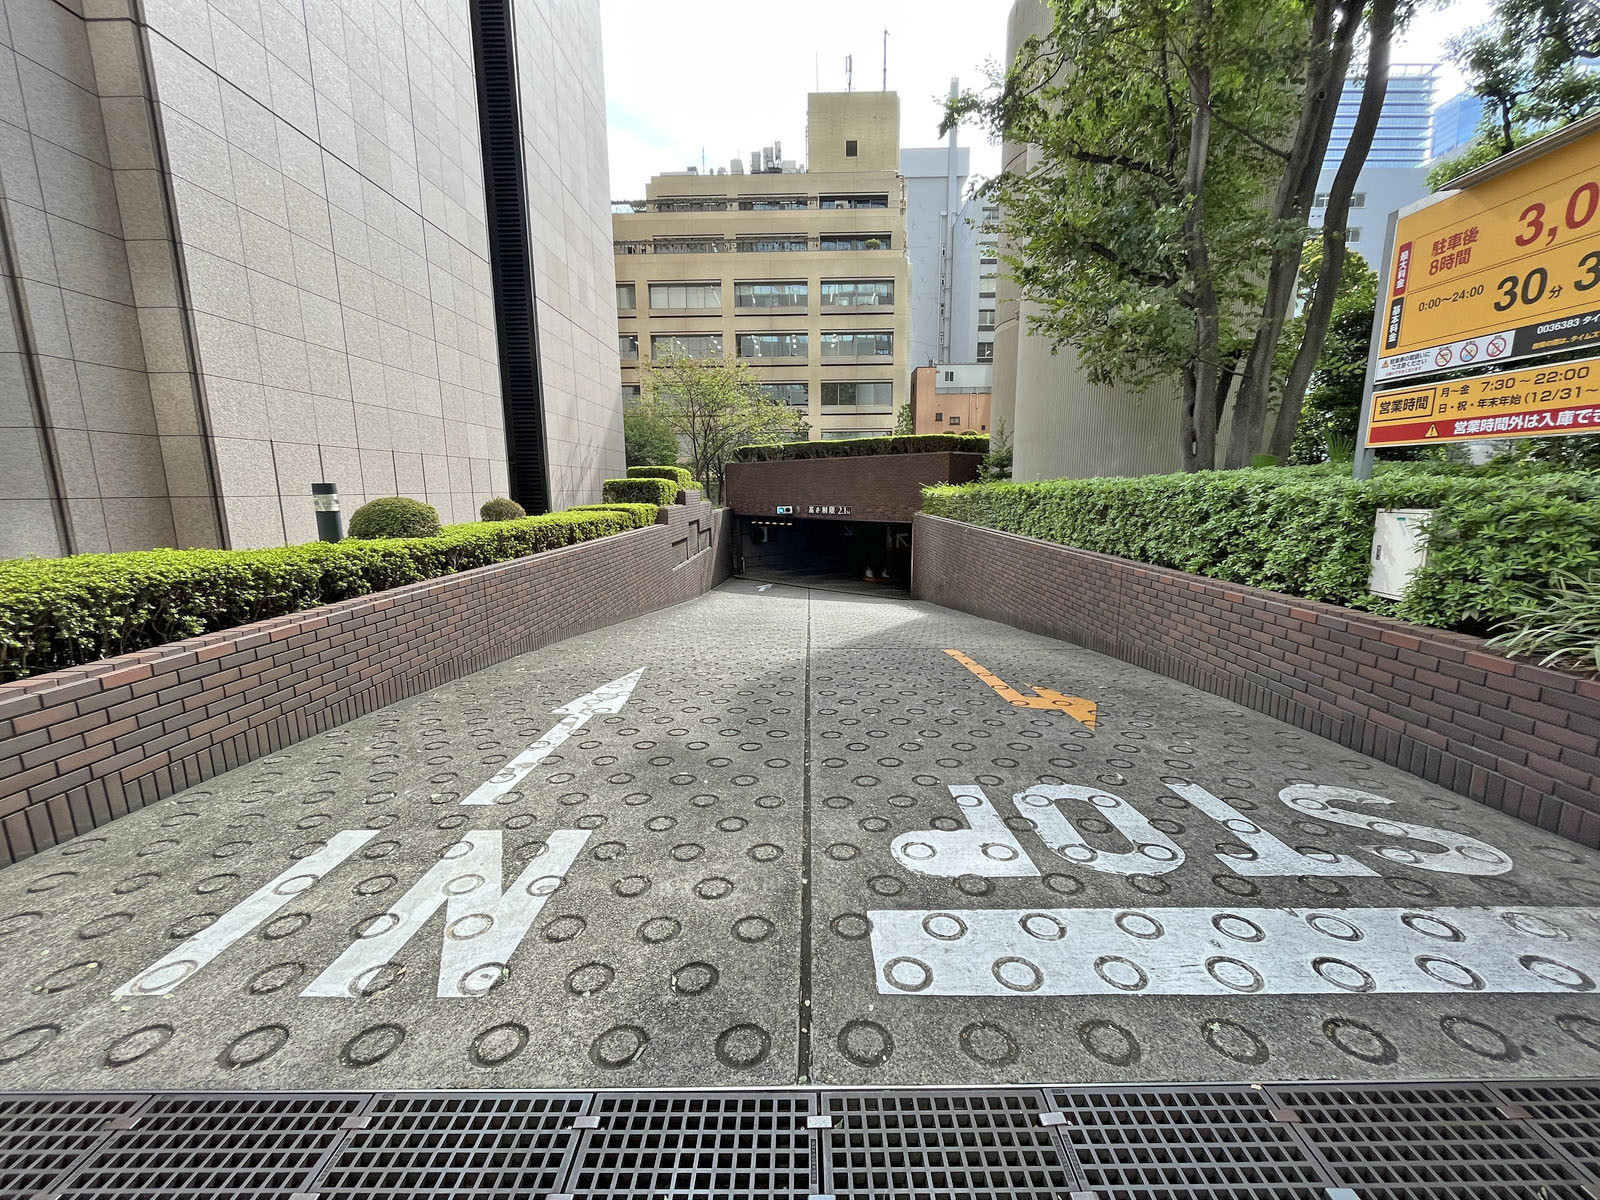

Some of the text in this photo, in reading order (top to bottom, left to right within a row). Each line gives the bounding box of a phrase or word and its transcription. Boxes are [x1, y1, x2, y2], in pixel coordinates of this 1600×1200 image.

[1431, 226, 1480, 257] 駐車後
[1428, 246, 1472, 276] 8時間
[1536, 317, 1580, 335] 0036383
[1379, 395, 1430, 415] 営業時間
[890, 782, 1514, 878] STOP
[110, 829, 592, 998] IN
